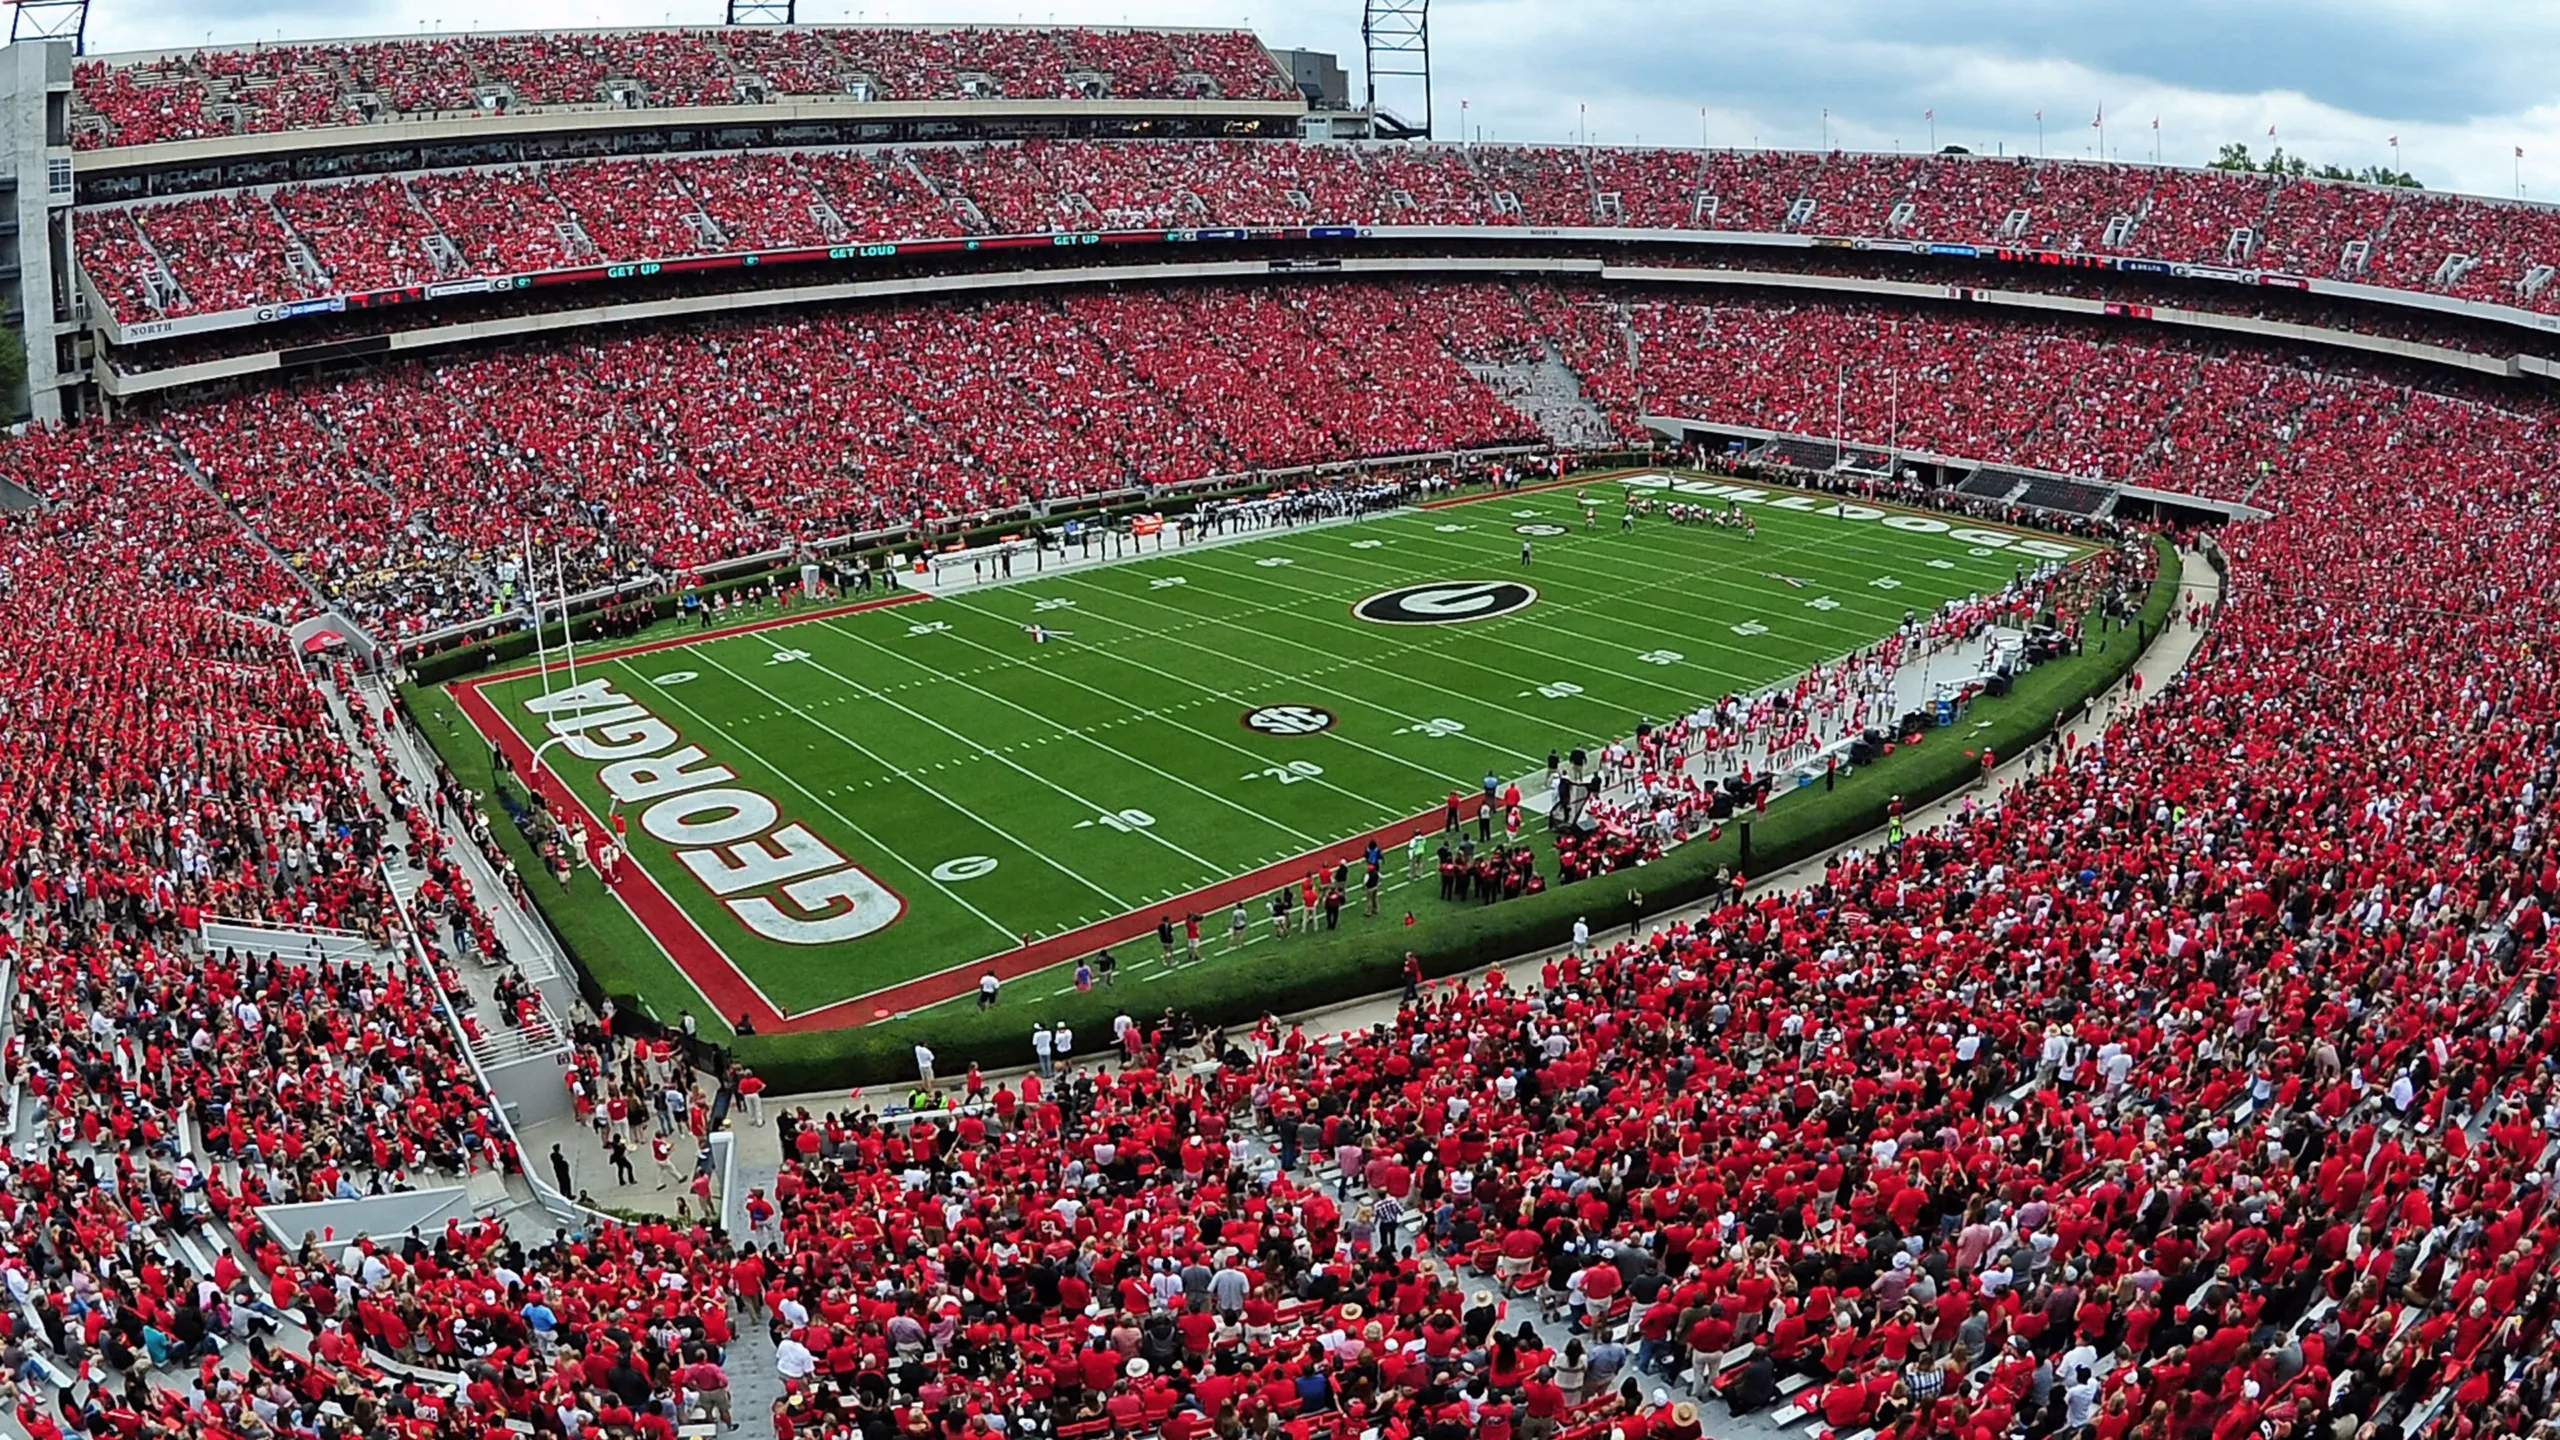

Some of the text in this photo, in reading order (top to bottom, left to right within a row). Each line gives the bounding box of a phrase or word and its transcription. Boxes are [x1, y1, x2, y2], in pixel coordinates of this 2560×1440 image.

[1053, 234, 1100, 245] GET UP
[829, 245, 896, 259] GET LOUD
[608, 263, 660, 278] GET UP
[257, 308, 274, 320] G
[130, 323, 172, 336] NORTH
[1617, 474, 2081, 559] BULLDOGS
[1637, 650, 1685, 665] 50
[1536, 681, 1585, 699] 40
[1249, 706, 1329, 733] SEC
[1411, 717, 1466, 738] 30
[1263, 760, 1325, 785] 20
[523, 677, 904, 944] GEORGIA
[1098, 808, 1157, 833] 10
[931, 855, 999, 881] G
